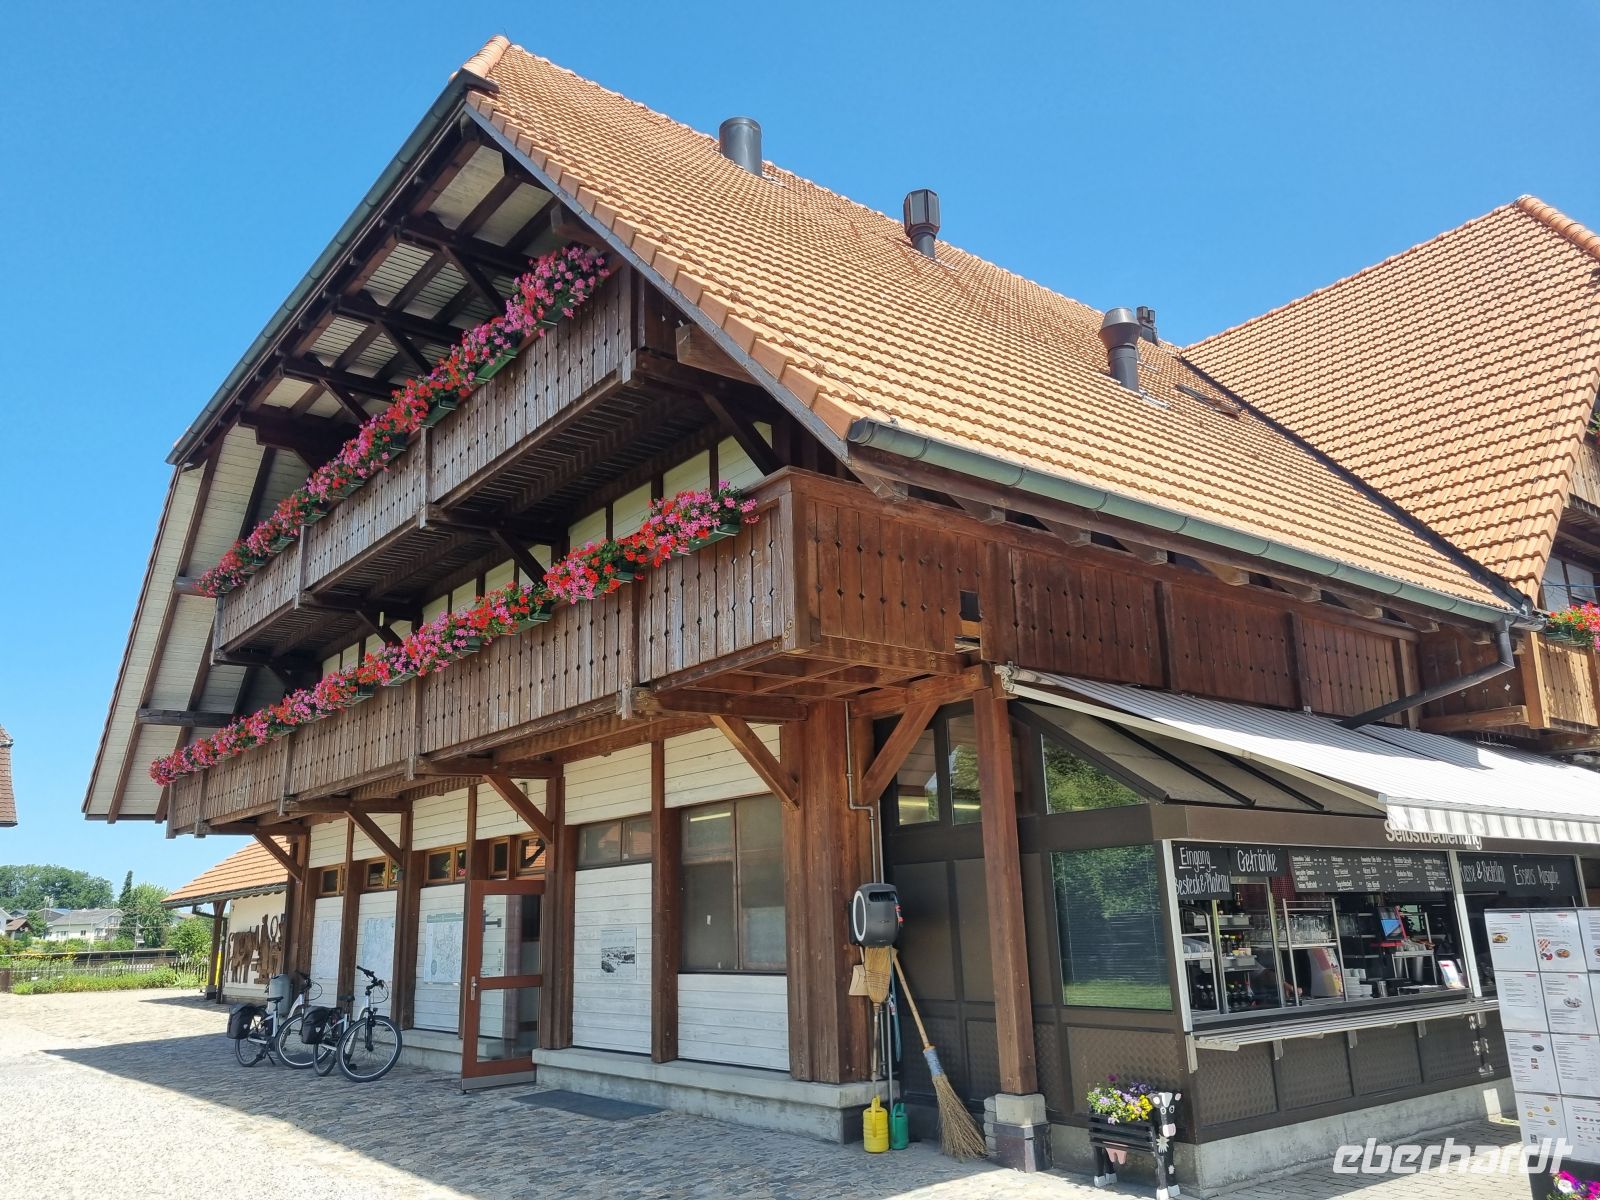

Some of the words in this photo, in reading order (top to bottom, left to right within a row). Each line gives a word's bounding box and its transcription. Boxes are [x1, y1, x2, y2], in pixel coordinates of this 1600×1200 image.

[1180, 847, 1211, 873] Eingang
[1237, 849, 1278, 873] Getränke
[1476, 861, 1483, 880] &
